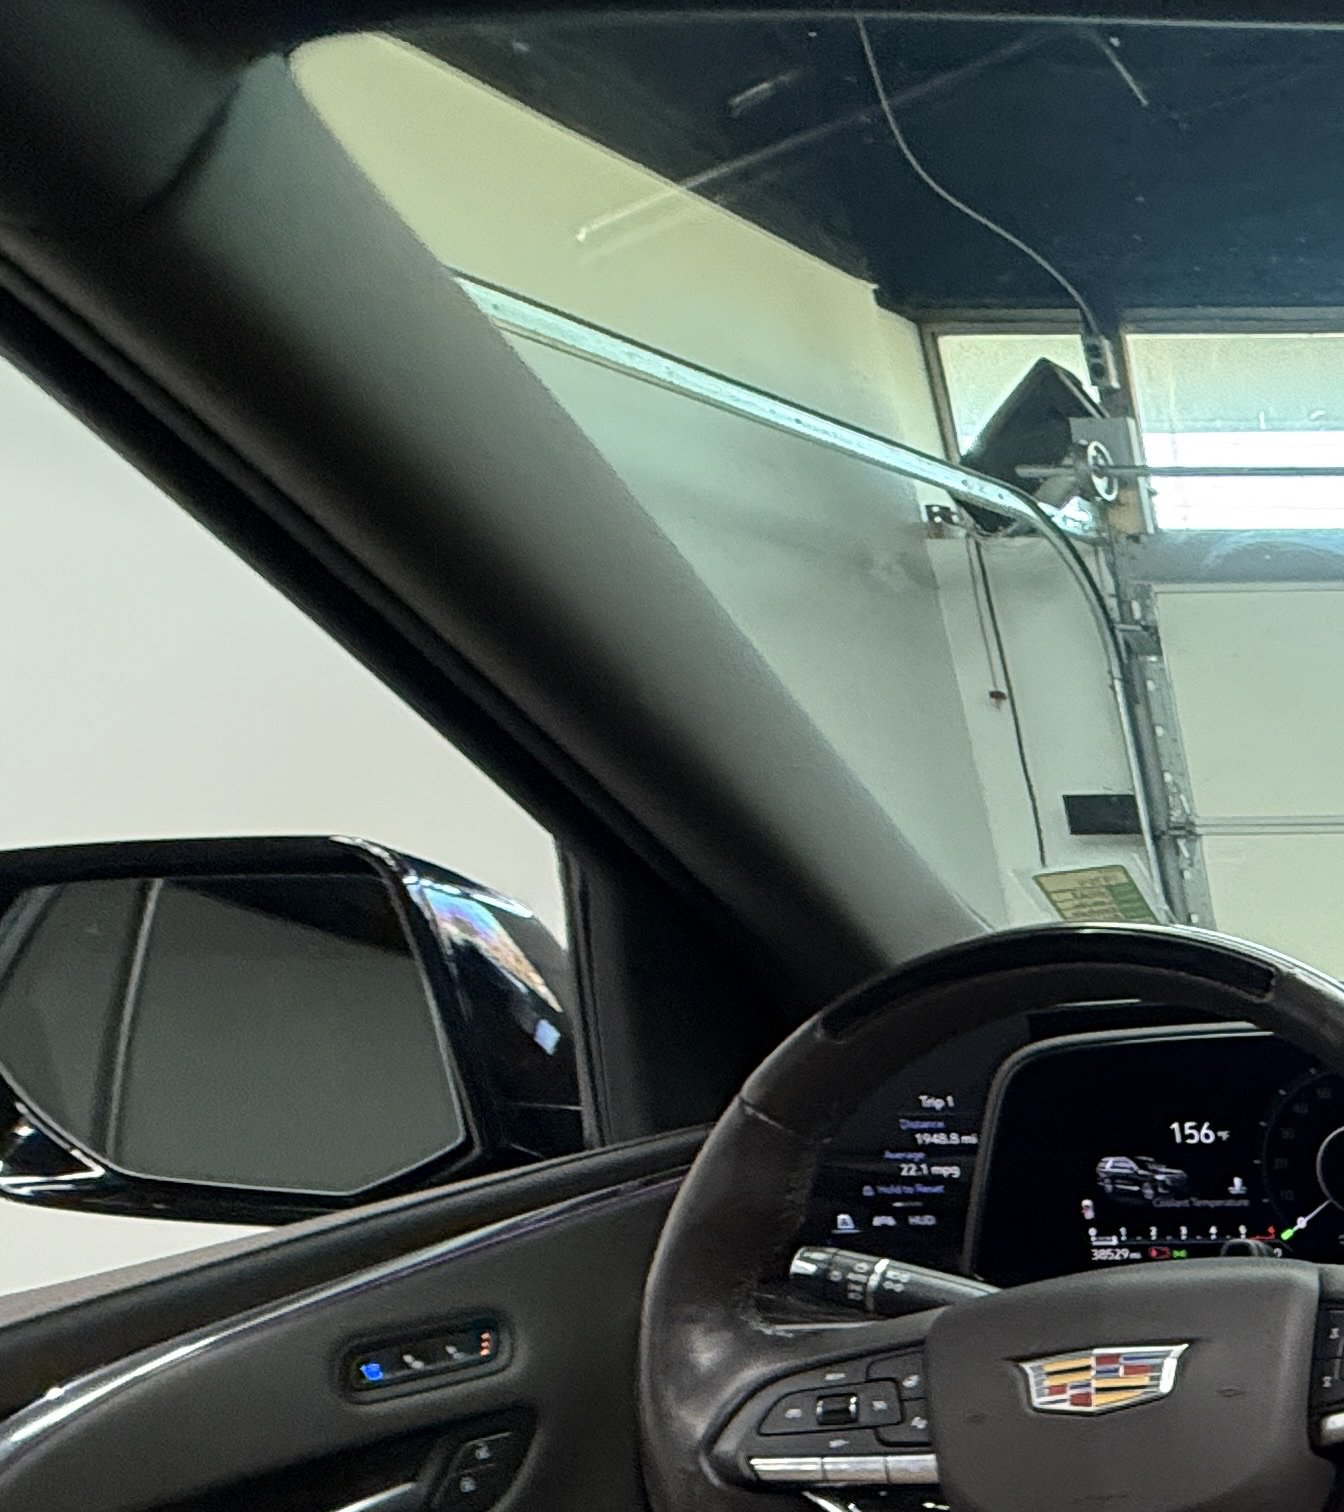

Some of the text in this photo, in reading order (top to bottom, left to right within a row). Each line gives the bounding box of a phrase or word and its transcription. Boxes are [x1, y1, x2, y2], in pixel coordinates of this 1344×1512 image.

[918, 1094, 955, 1111] Trip 1
[1169, 1121, 1216, 1145] 156
[900, 1163, 961, 1178] 22.1 mpg
